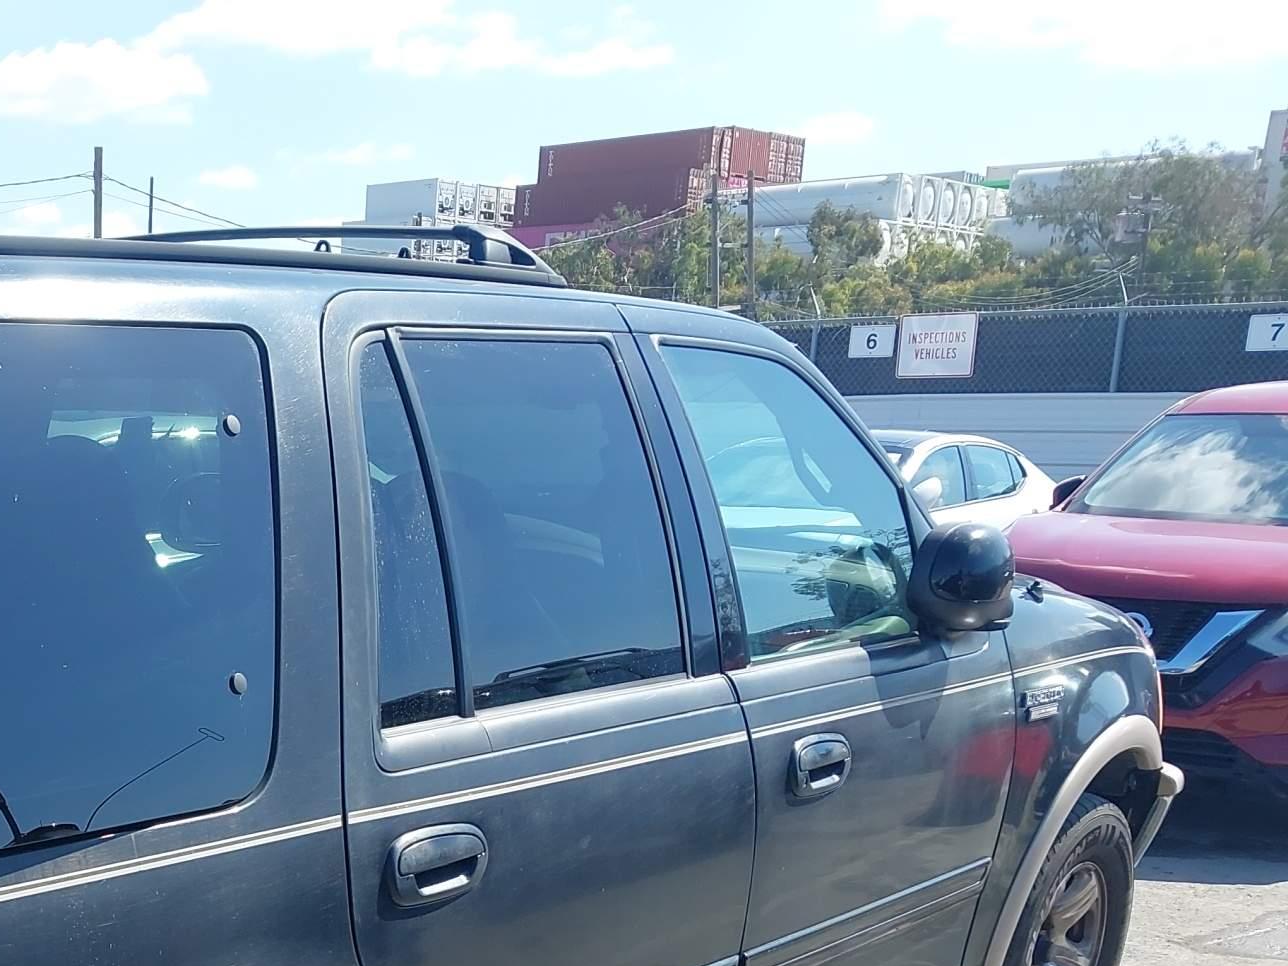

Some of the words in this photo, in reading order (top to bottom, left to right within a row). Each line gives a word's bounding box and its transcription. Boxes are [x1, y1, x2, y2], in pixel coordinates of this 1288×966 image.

[907, 331, 967, 345] INSPECTIONS
[1271, 323, 1285, 341] 7
[866, 333, 878, 350] 6
[914, 347, 958, 361] VEHICLES
